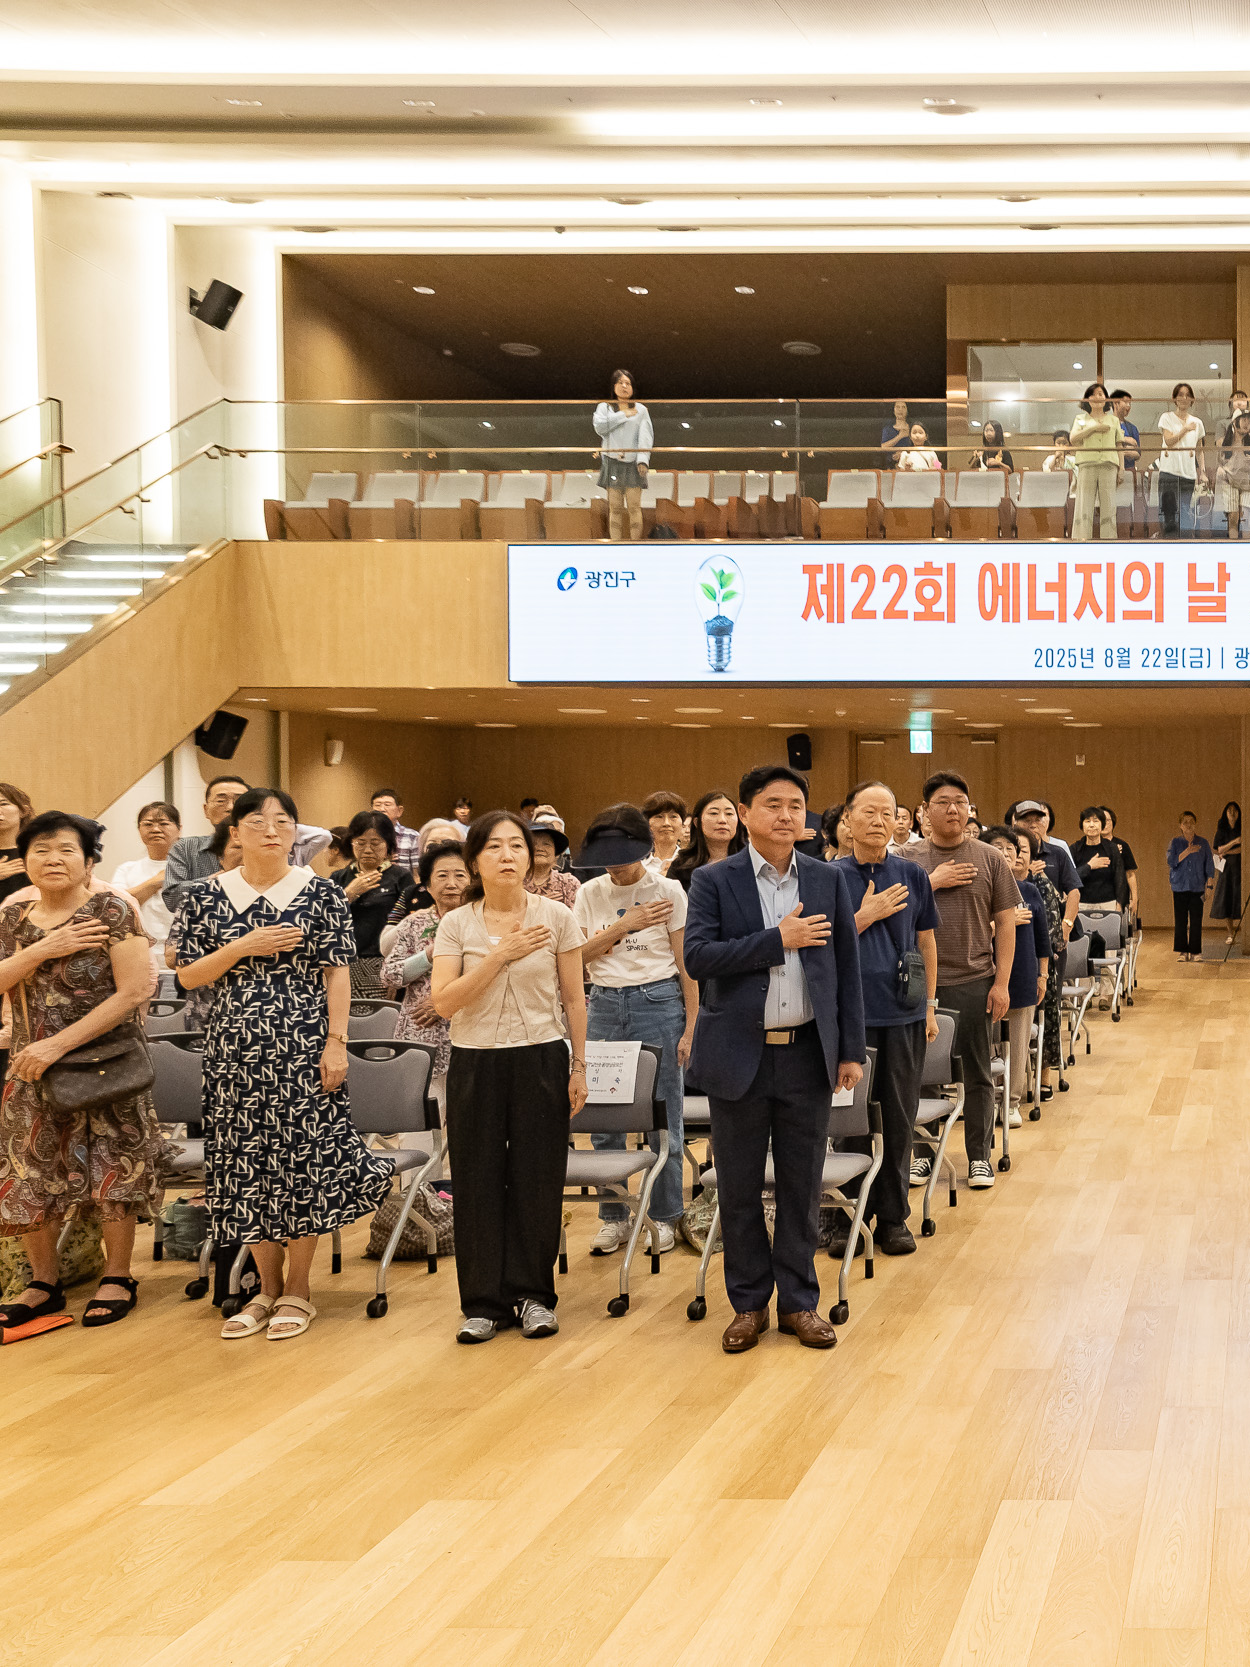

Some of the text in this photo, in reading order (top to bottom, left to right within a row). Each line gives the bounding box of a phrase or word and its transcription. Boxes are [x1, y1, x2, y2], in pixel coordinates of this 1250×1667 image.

[584, 570, 636, 590] 광진구
[800, 561, 956, 624] 제22회
[977, 561, 1165, 624] 에너지의
[1187, 561, 1231, 623] 날
[1034, 647, 1094, 669] 2025년
[1104, 647, 1131, 669] 8월
[1141, 647, 1212, 669] 22일(금)
